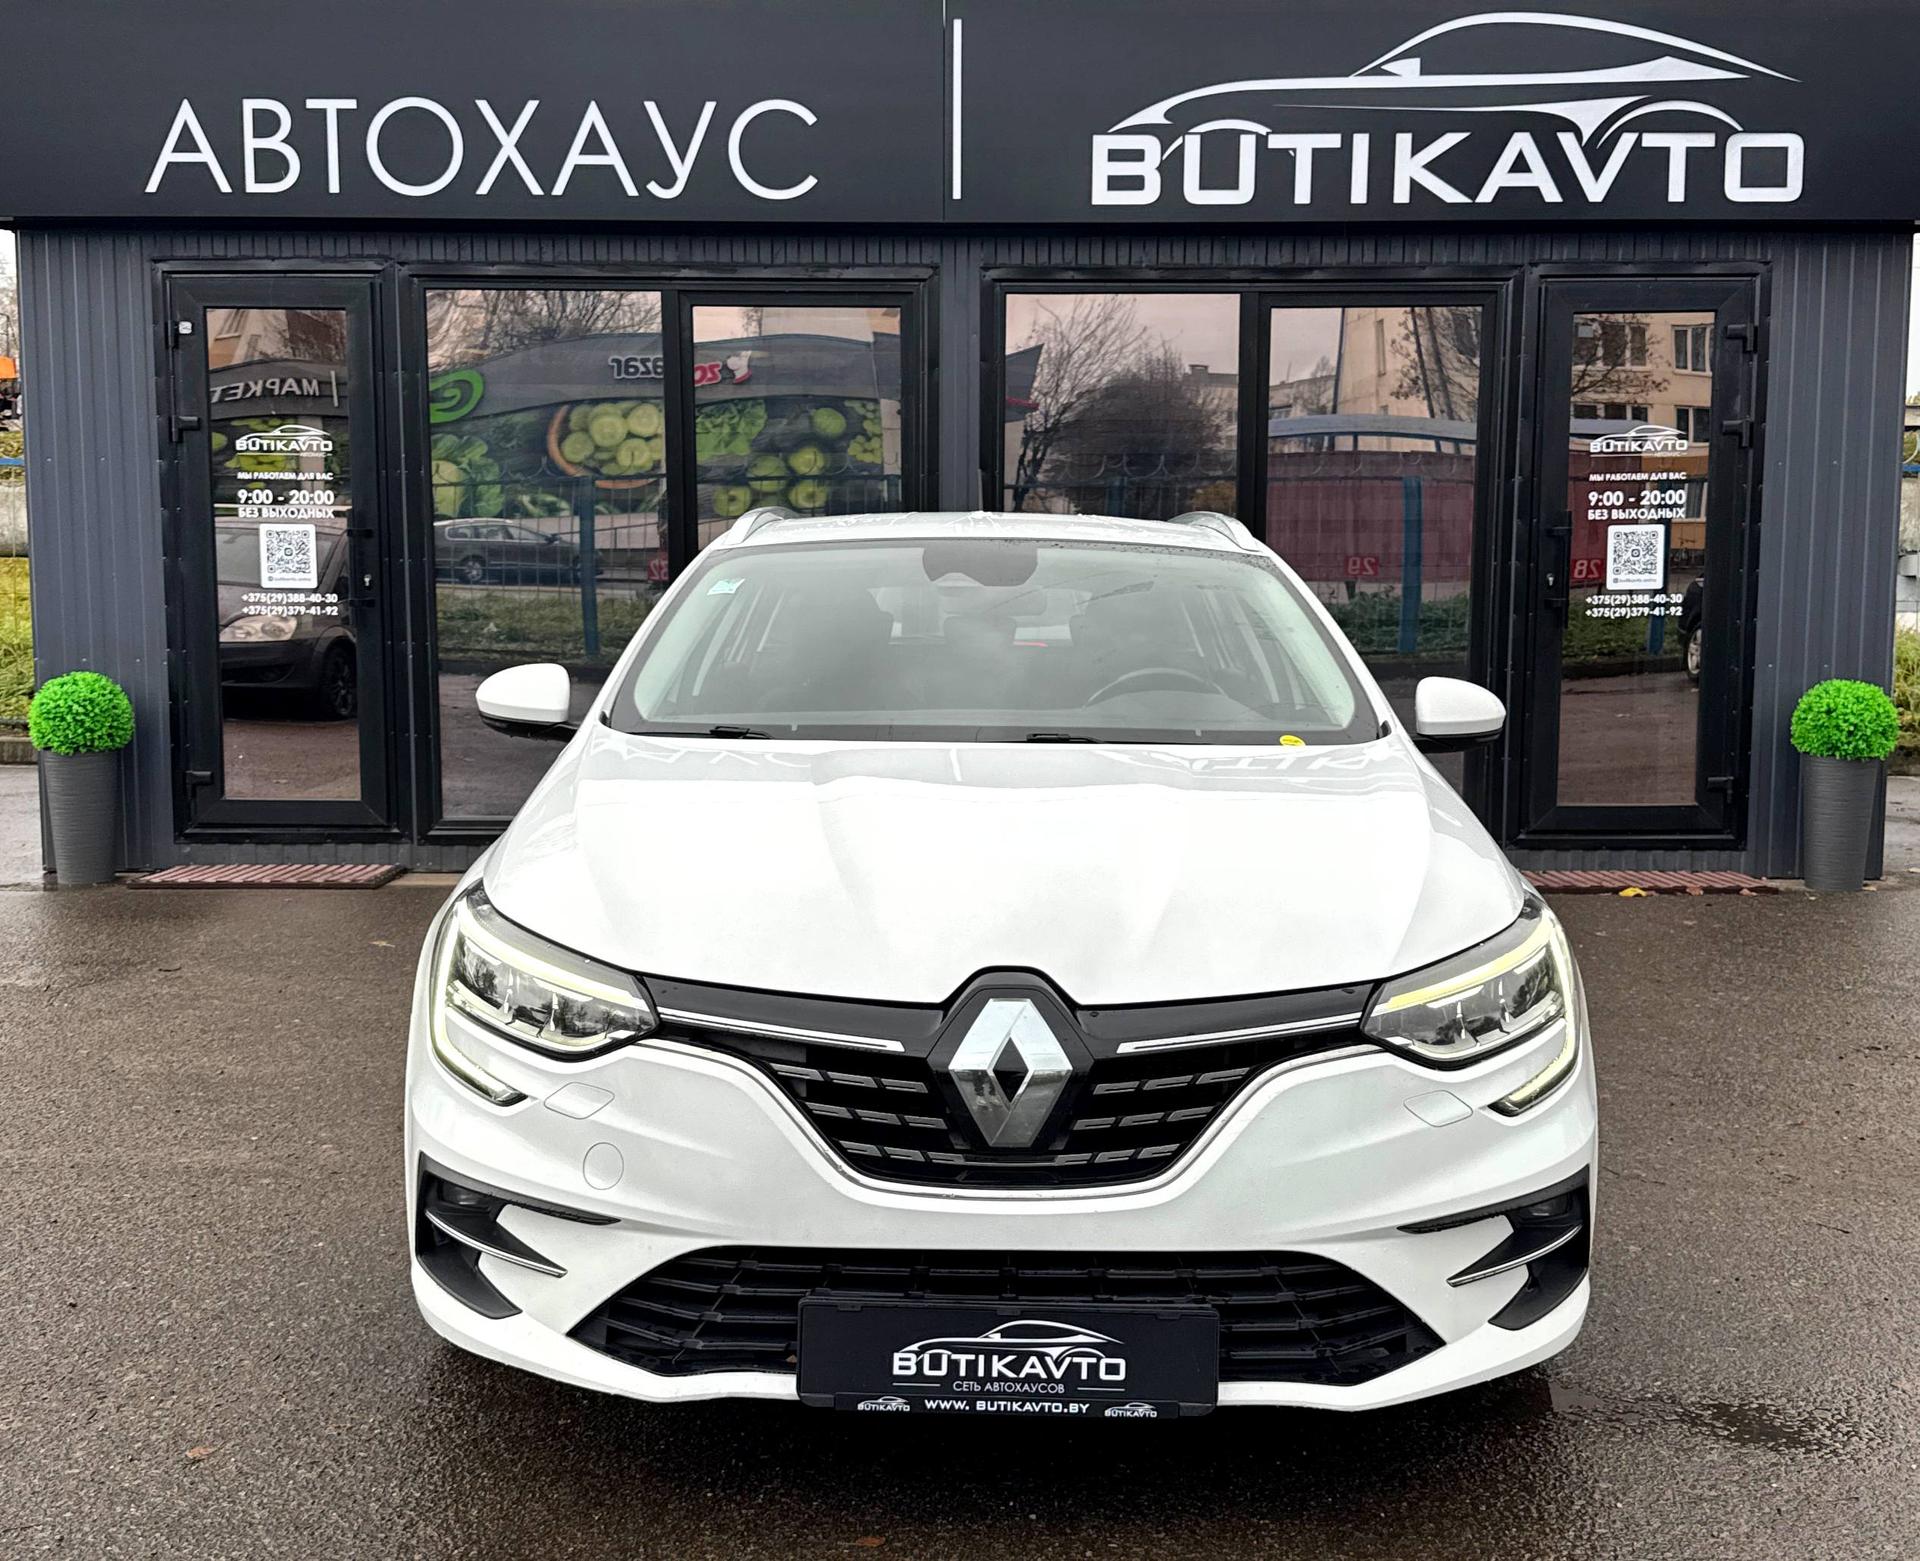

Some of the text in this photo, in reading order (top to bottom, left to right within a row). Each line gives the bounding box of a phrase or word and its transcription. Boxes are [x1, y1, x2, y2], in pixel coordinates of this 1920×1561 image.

[144, 96, 818, 200] АВТОХАУС
[1091, 131, 1805, 206] BUTIKAVTO
[235, 439, 333, 451] BUTIKAVTO
[1590, 440, 1688, 453] BUTIKAVTO
[316, 472, 334, 480] ВАС
[1668, 472, 1687, 480] ВАС
[237, 489, 273, 504] 9:00
[288, 489, 335, 505] 20:00
[1588, 491, 1624, 506] 9:00
[1640, 489, 1686, 505] 20:00
[238, 507, 335, 519] БЕЗ ВЫХОДНЫХ
[1588, 507, 1686, 520] БЕЗ ВЫХОДНЫХ
[241, 592, 338, 604] +375(29)388-40-30
[1585, 593, 1683, 606] +375(29)388-40-30
[241, 605, 338, 617] +375(29)379-41-92
[1585, 606, 1683, 619] +375(29)379-41-92
[892, 1351, 1126, 1381] BUTIKAVTO
[953, 1380, 1065, 1394] СЕТЬ АВТОХАУСОВ
[857, 1402, 910, 1412] BUTIKAVTO
[924, 1399, 1090, 1414] WWW. BUTIKAVTO.BY
[1104, 1408, 1158, 1418] BUTIKAVTO
